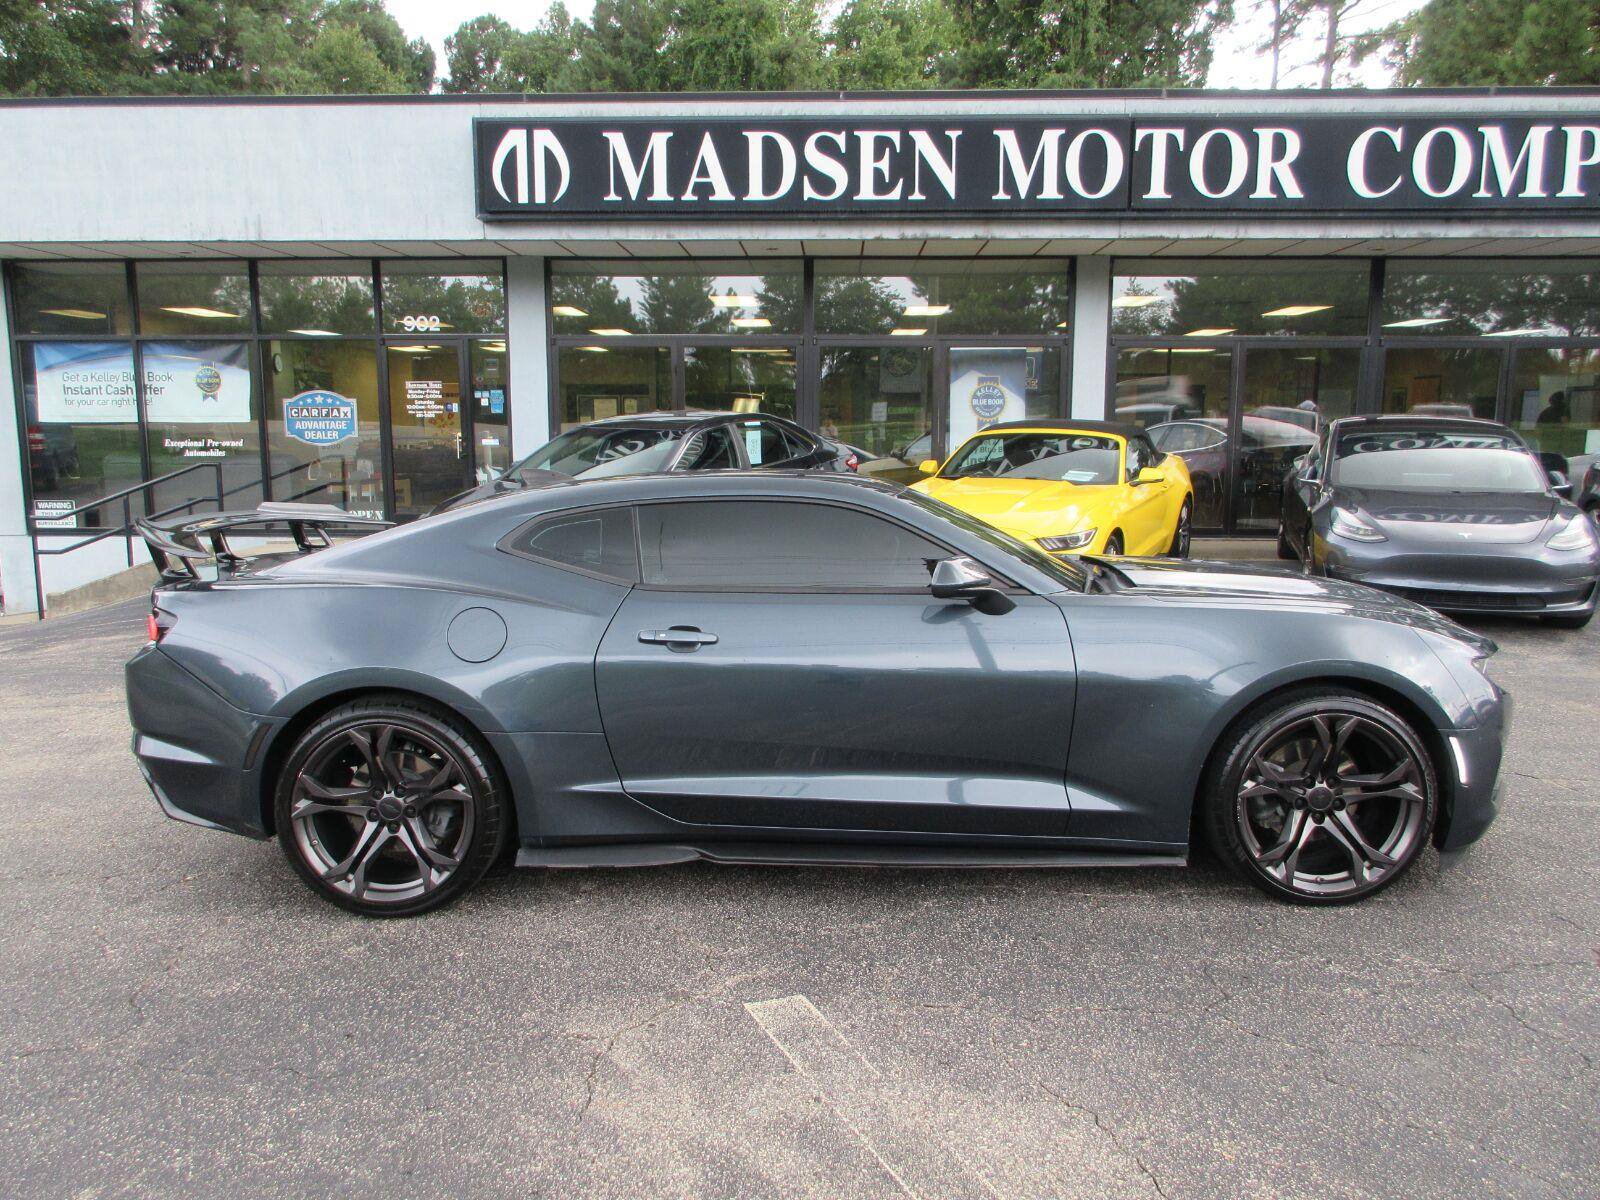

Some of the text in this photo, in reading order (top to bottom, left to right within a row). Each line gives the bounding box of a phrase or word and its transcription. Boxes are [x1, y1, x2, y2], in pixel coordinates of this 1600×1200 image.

[602, 129, 963, 201] MADSEN
[991, 128, 1304, 200] MOTOR
[403, 315, 441, 331] 902
[62, 371, 80, 382] Get
[82, 373, 89, 382] a
[90, 371, 120, 384] Kelley
[147, 371, 174, 382] Book
[63, 384, 165, 396] Instant Cash ffer
[64, 398, 75, 406] for
[77, 399, 94, 408] your
[111, 398, 131, 408] right
[972, 398, 1004, 406] BLUE BOOK
[290, 407, 351, 418] CARFAX
[295, 420, 348, 430] ADVANTAGE
[304, 430, 339, 440] DEALER
[164, 438, 244, 448] Exceptional Pre-owned
[183, 448, 226, 457] Automobiles
[37, 501, 72, 509] WARNING
